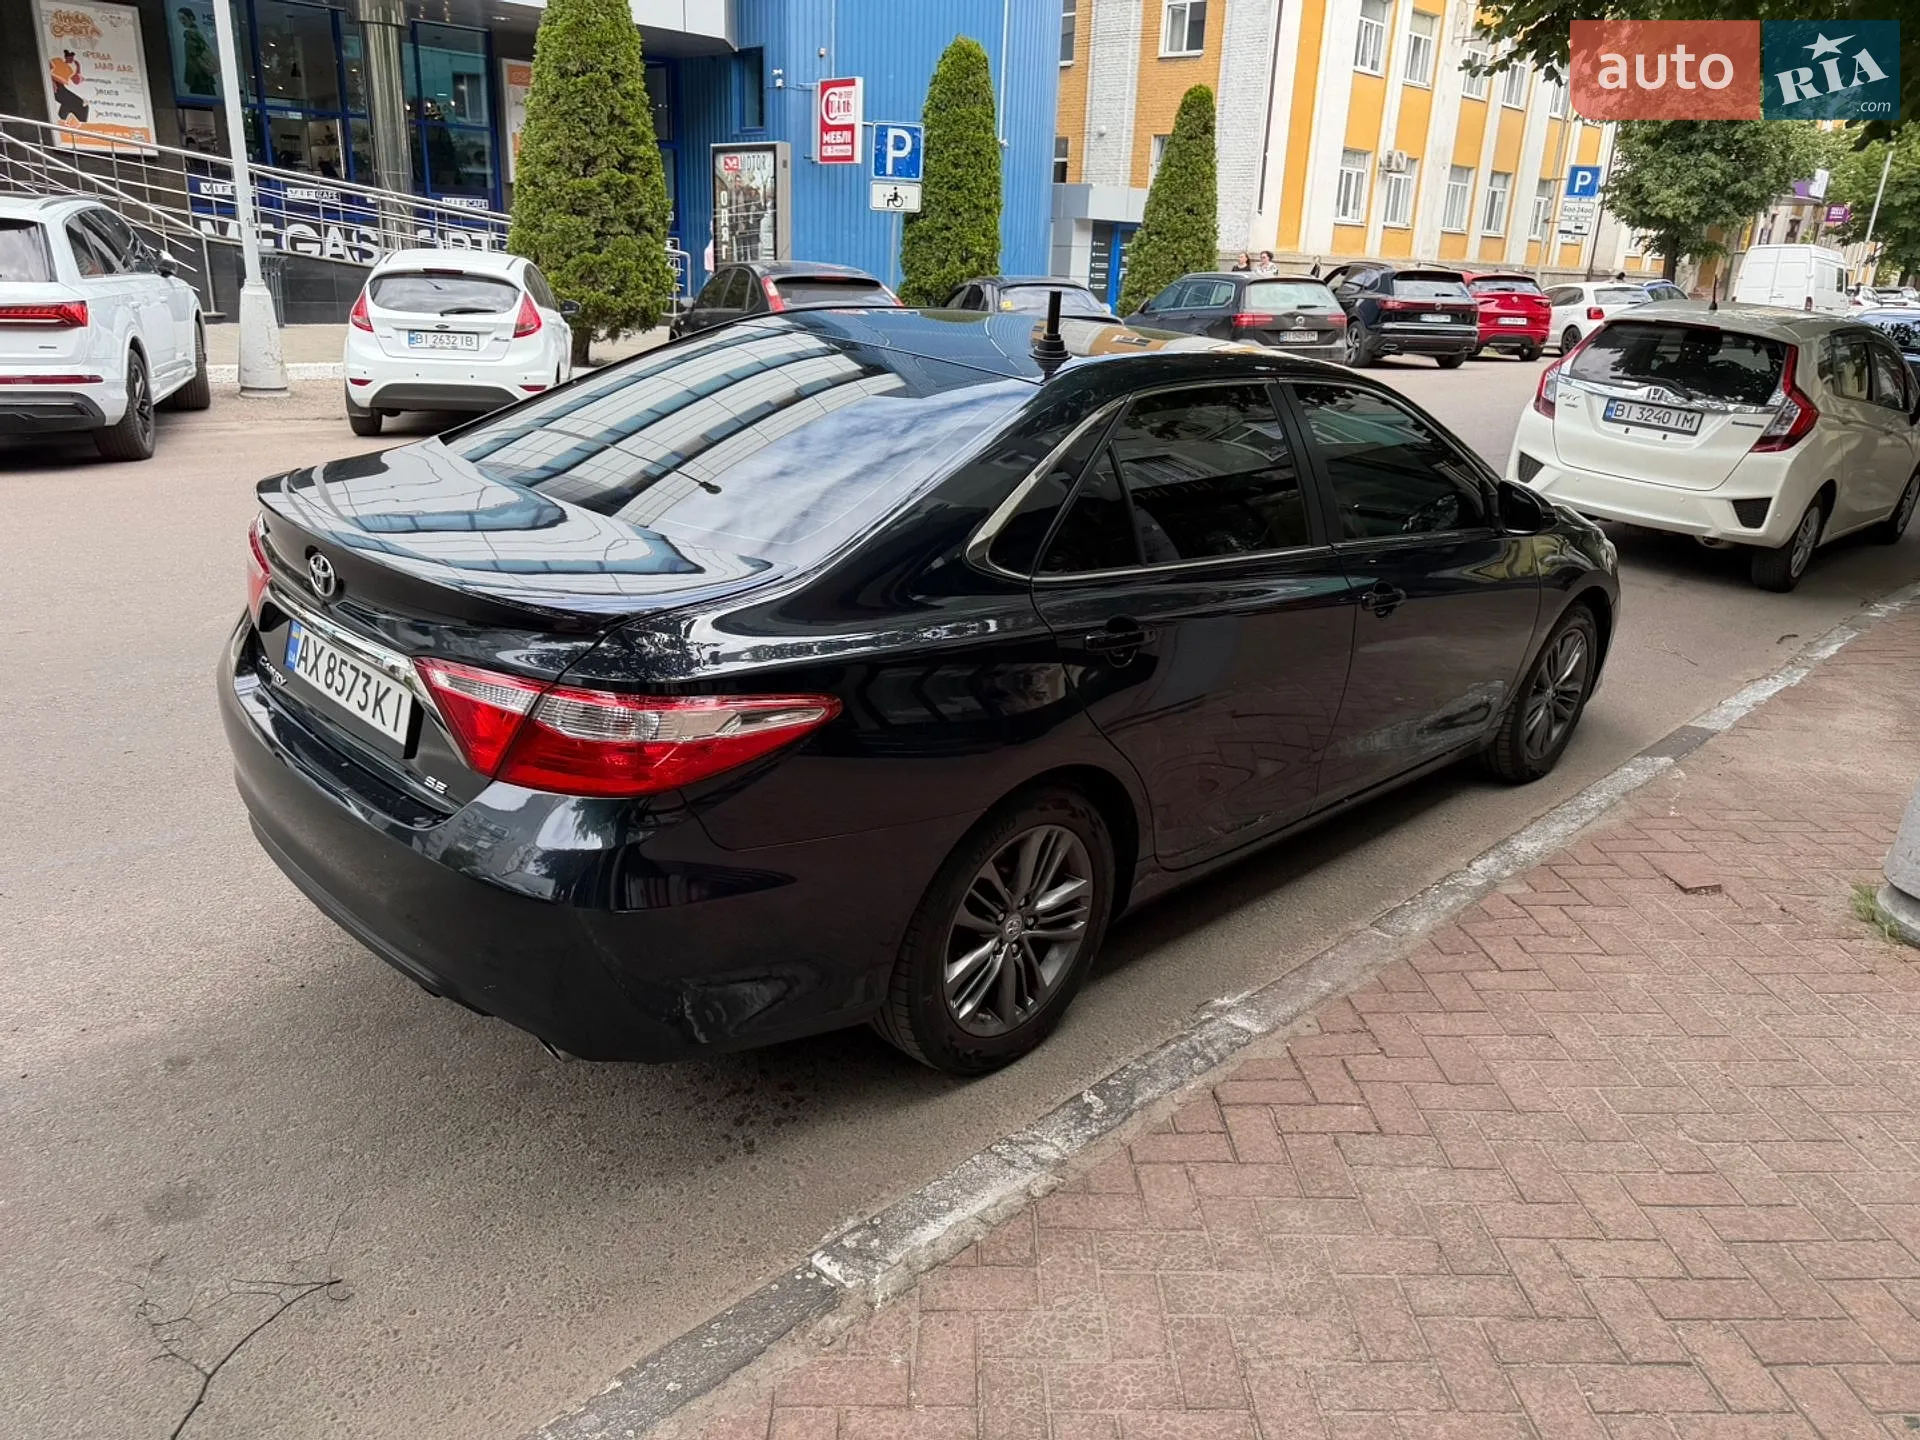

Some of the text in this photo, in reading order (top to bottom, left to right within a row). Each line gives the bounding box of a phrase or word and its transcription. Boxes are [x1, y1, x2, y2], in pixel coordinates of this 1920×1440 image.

[886, 128, 912, 175] P
[1574, 171, 1592, 193] P
[415, 333, 428, 344] BI
[432, 334, 457, 346] 2632
[1614, 402, 1696, 429] BI 3240 IM
[296, 634, 403, 733] AX 8573 KI
[424, 776, 448, 795] SE
